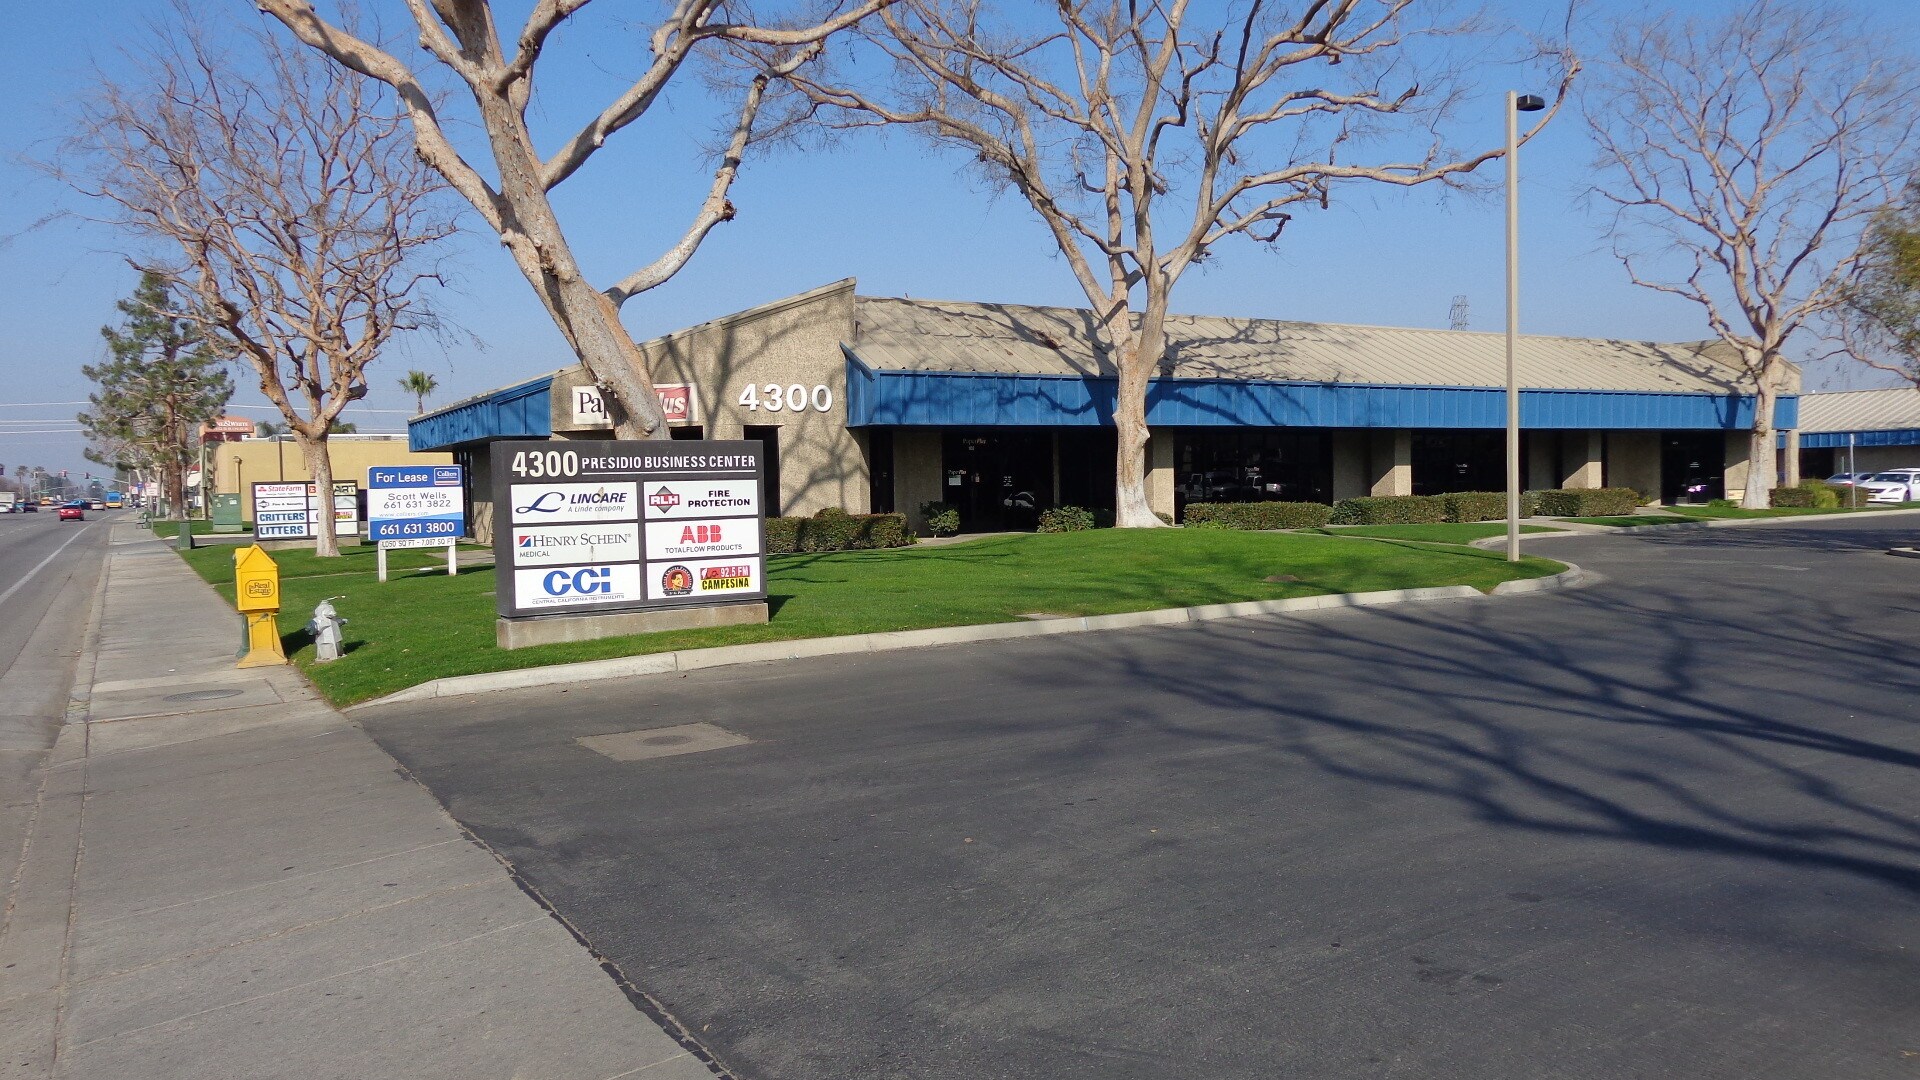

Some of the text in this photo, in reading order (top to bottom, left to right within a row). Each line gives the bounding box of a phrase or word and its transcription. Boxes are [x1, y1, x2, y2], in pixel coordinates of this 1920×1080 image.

[739, 384, 833, 412] 4300
[512, 450, 756, 478] 4300 PRESIDIO BUSINESS CENTER
[376, 472, 428, 483] For Lease
[387, 491, 447, 501] Scott Wells
[570, 492, 628, 504] LINCARE
[708, 489, 730, 498] FIRE
[383, 499, 451, 509] 661 631 3822
[650, 495, 679, 505] RLH
[688, 498, 751, 508] PROTECTION
[595, 505, 625, 513] company
[259, 512, 305, 522] CRITTERS
[260, 525, 304, 535] LITTERS
[380, 521, 455, 535] 661 631 3800
[680, 524, 722, 545] ABB
[532, 534, 579, 547] HENRY
[519, 550, 550, 558] MEDICAL
[665, 544, 743, 554] TOTALFLOW PRODUCTS
[720, 566, 737, 578] 92.5
[737, 565, 749, 577] FM
[702, 577, 750, 590] CAMPESINA
